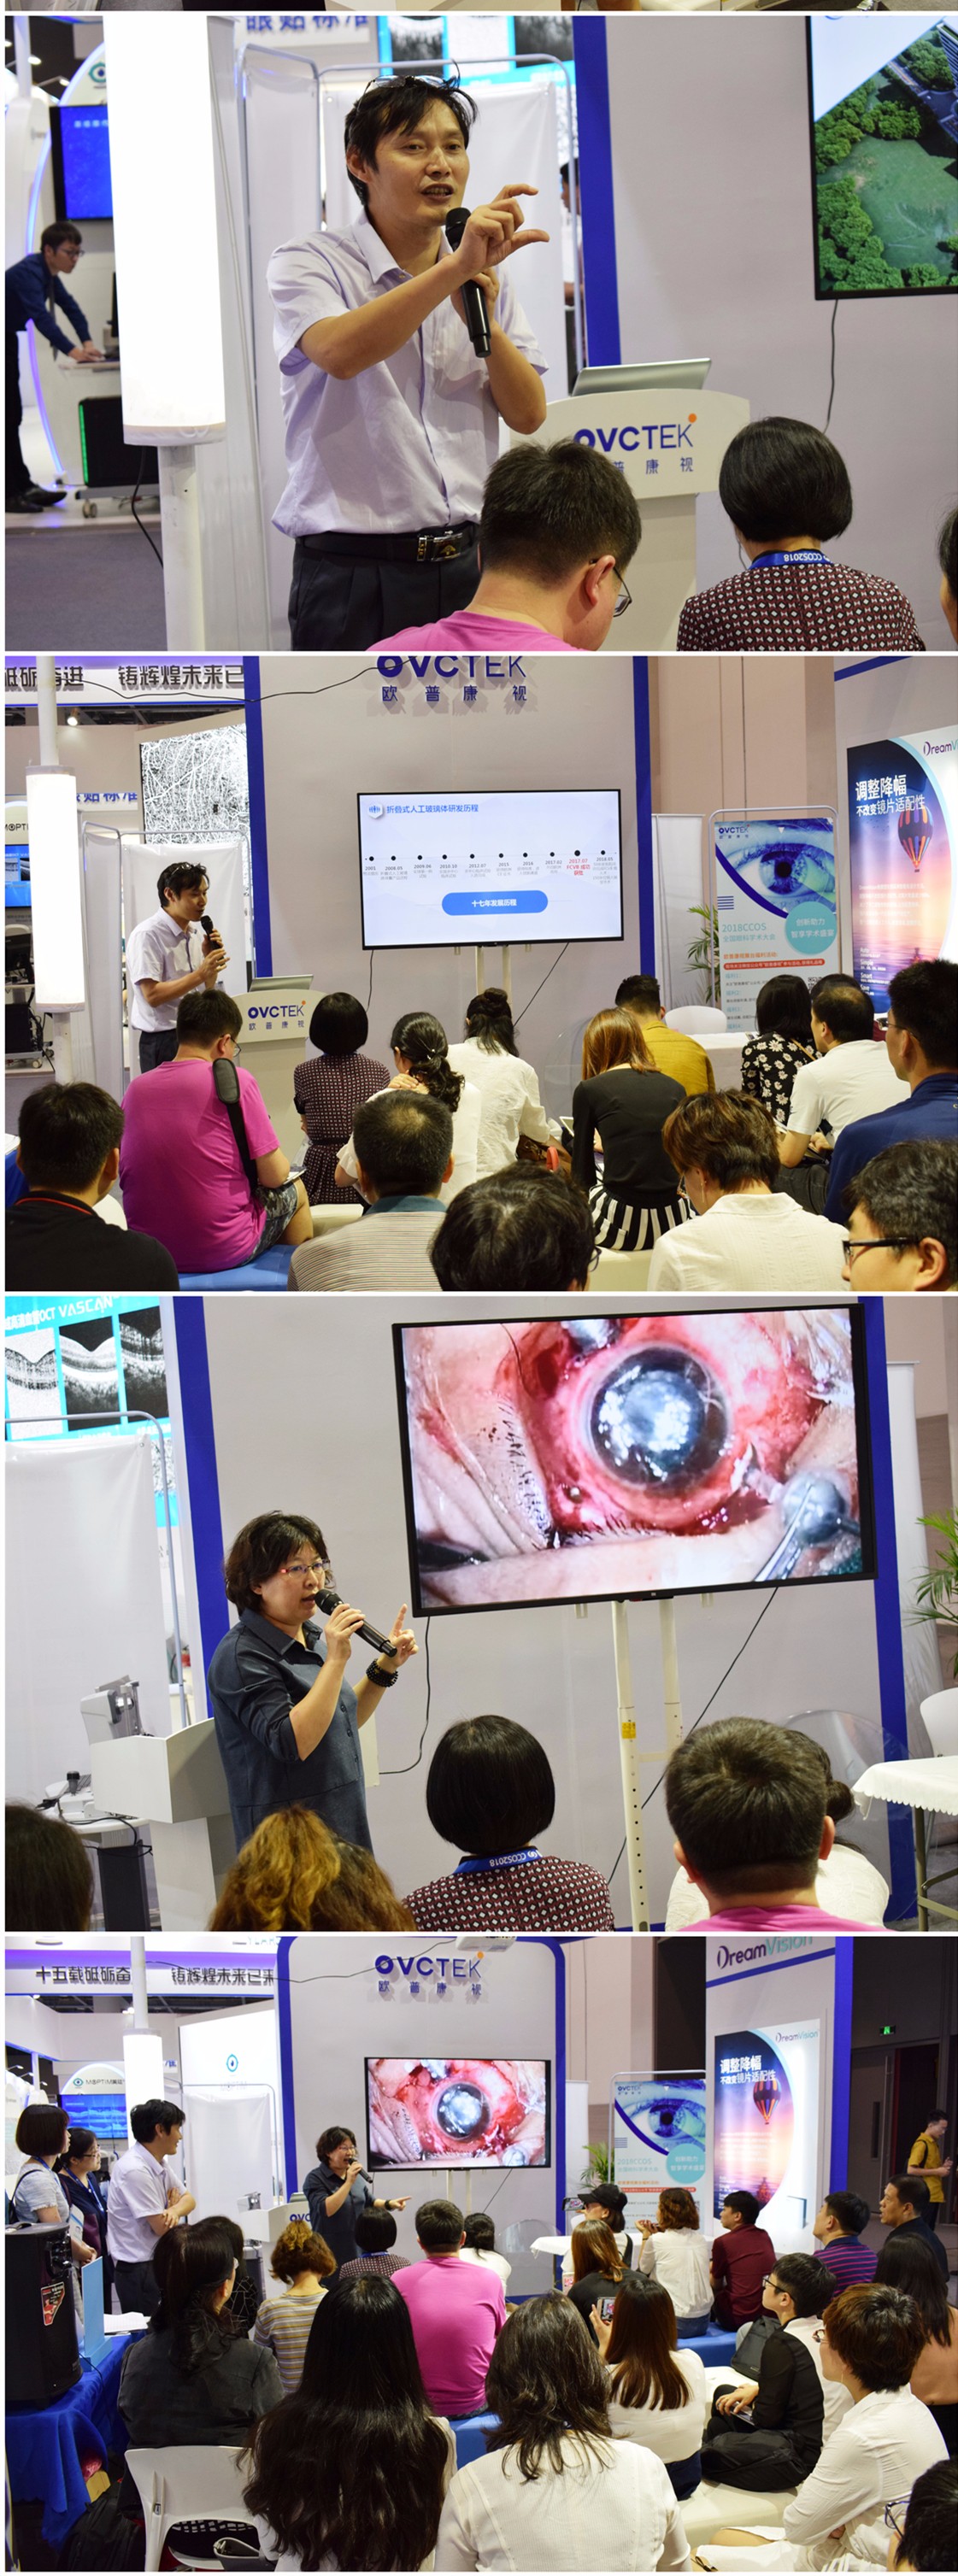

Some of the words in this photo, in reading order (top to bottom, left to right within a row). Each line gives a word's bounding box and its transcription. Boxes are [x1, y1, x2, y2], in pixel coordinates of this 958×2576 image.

[573, 424, 693, 452] OVCTEK
[784, 553, 822, 561] CCOS2018
[377, 655, 526, 678] OVCTEK
[118, 665, 244, 686] 铸辉煌未来已
[382, 685, 526, 701] 欧普康视
[855, 774, 907, 801] 调整降幅
[386, 804, 479, 813] 折叠式人工玻璃体研发历程
[855, 795, 925, 817] 不改变镜片适配性
[722, 923, 767, 932] 2018CCOS
[248, 1006, 304, 1018] OVCTEK
[490, 1852, 526, 1867] CCOS2018
[375, 1955, 481, 1978] OVCTEK
[379, 1980, 481, 1995] 欧普康视
[775, 2031, 818, 2043] DreamVision
[720, 2055, 761, 2074] 调整降幅
